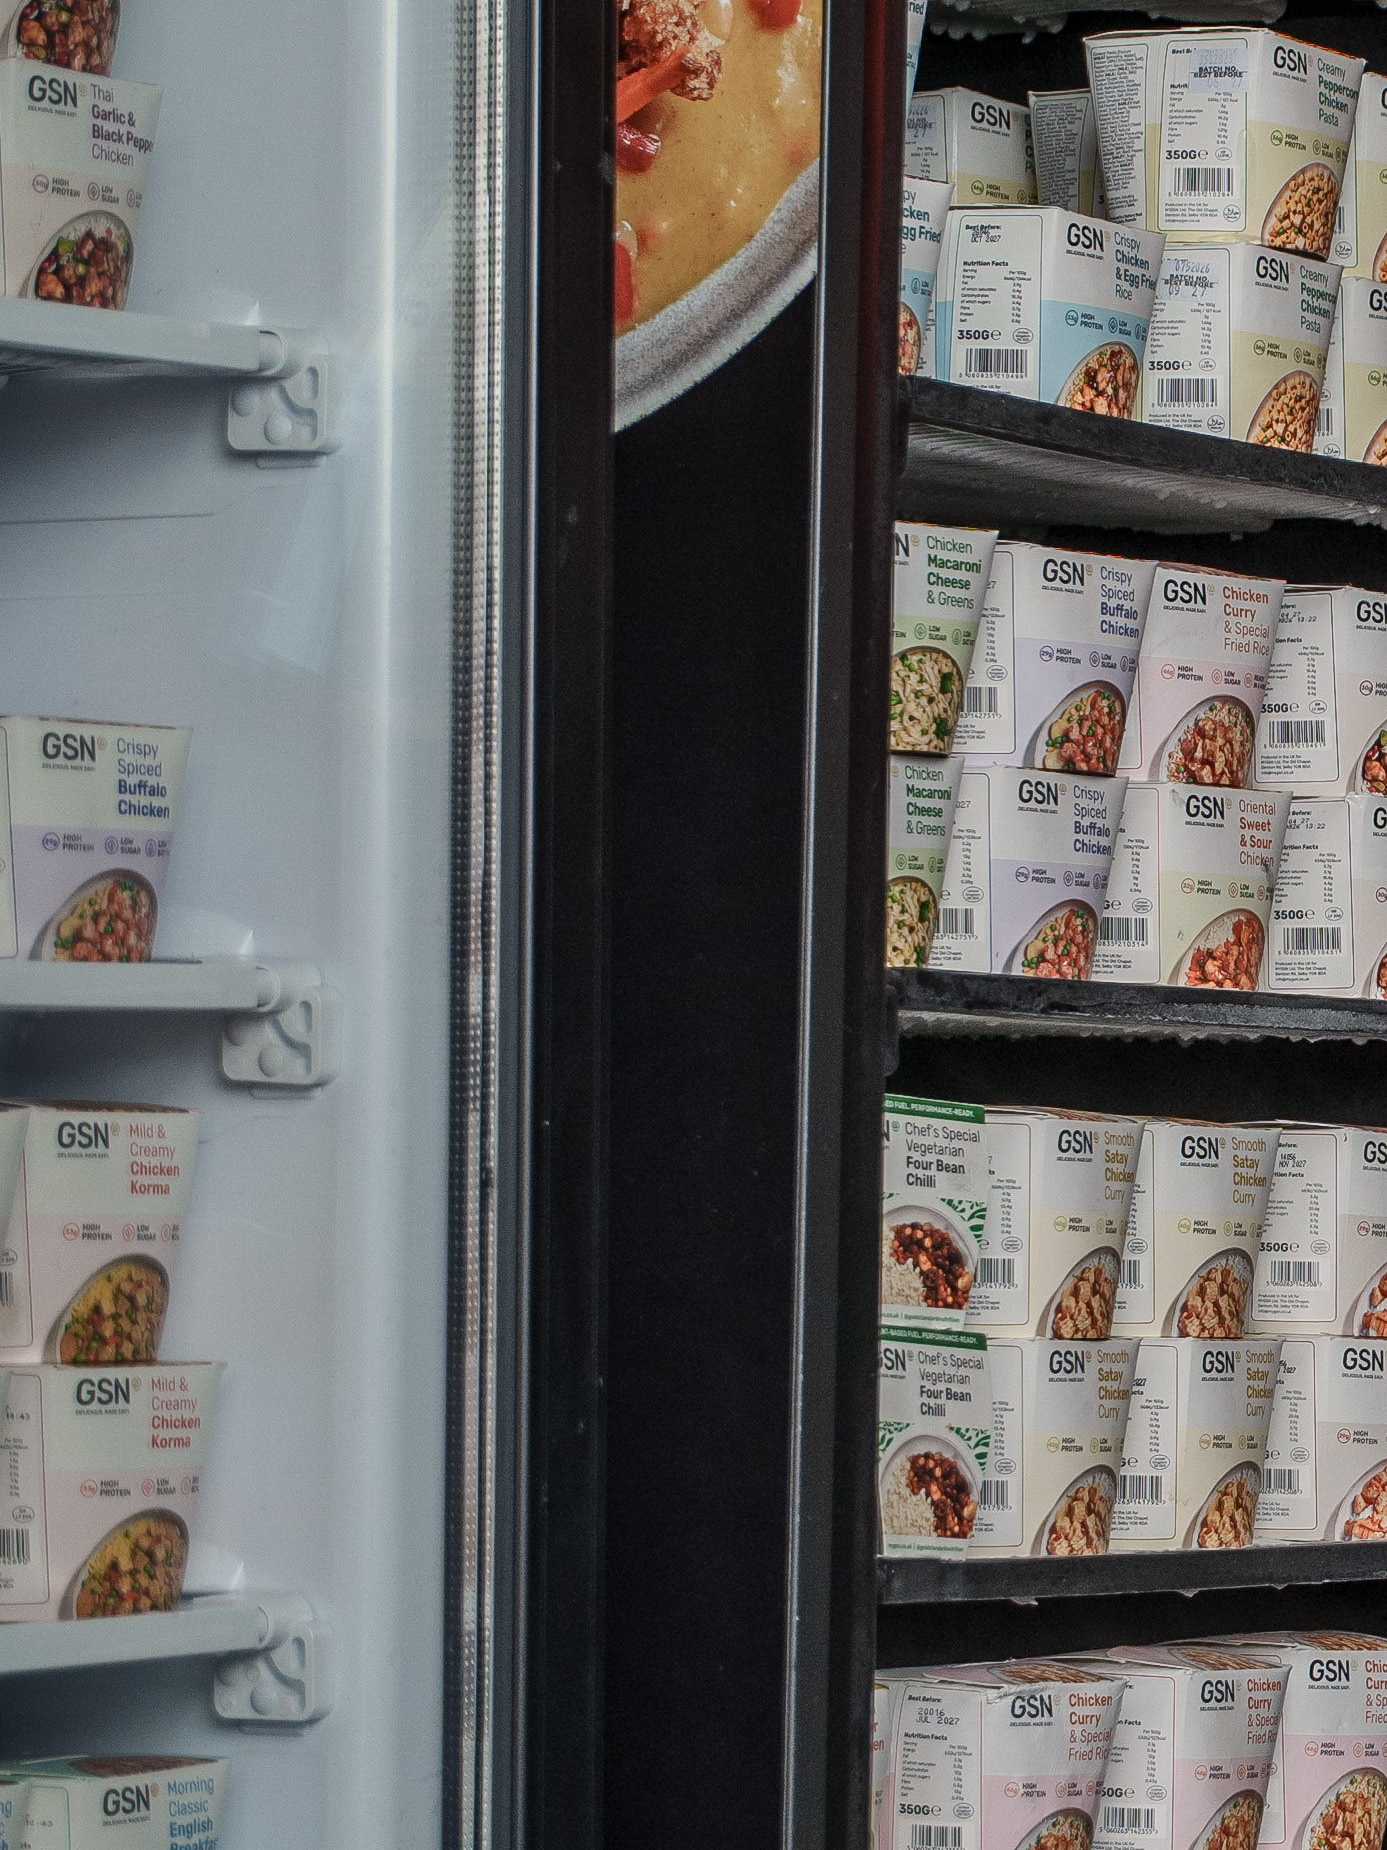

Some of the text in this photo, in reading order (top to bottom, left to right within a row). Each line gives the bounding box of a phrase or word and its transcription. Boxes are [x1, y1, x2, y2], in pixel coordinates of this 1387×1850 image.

[1273, 45, 1308, 76] GSN
[1317, 57, 1347, 78] Creamy
[1318, 92, 1349, 114] Chicken
[1318, 108, 1339, 127] Pasta
[1165, 149, 1199, 160] 350G
[1066, 222, 1105, 253] GSN
[1114, 232, 1141, 253] Crispy
[1115, 249, 1150, 271] Chicken
[1115, 271, 1143, 290] & Egg
[1115, 283, 1133, 301] Rice
[957, 329, 990, 341] 350G
[926, 536, 973, 555] Chicken
[927, 554, 982, 574] Macaroni
[927, 572, 971, 590] Cheese
[927, 591, 974, 610] & Greens
[42, 732, 96, 762] GSN
[117, 738, 158, 758] Crispy
[118, 759, 162, 777] Spiced
[118, 779, 167, 798] Buffalo
[118, 800, 170, 819] Chicken
[1185, 794, 1225, 821] GSN
[1238, 799, 1276, 816] Oriental
[1239, 817, 1272, 832] Sweet
[1240, 835, 1272, 850] & Sour
[1239, 850, 1274, 867] Chicken
[57, 1121, 110, 1150] GSN
[129, 1123, 166, 1138] Mild &
[130, 1142, 176, 1160] Creamy
[131, 1161, 180, 1176] Chicken
[131, 1180, 170, 1195] Korma
[1342, 1347, 1385, 1373] GSN
[937, 1717, 960, 1726] 2027
[899, 1803, 930, 1815] 350G
